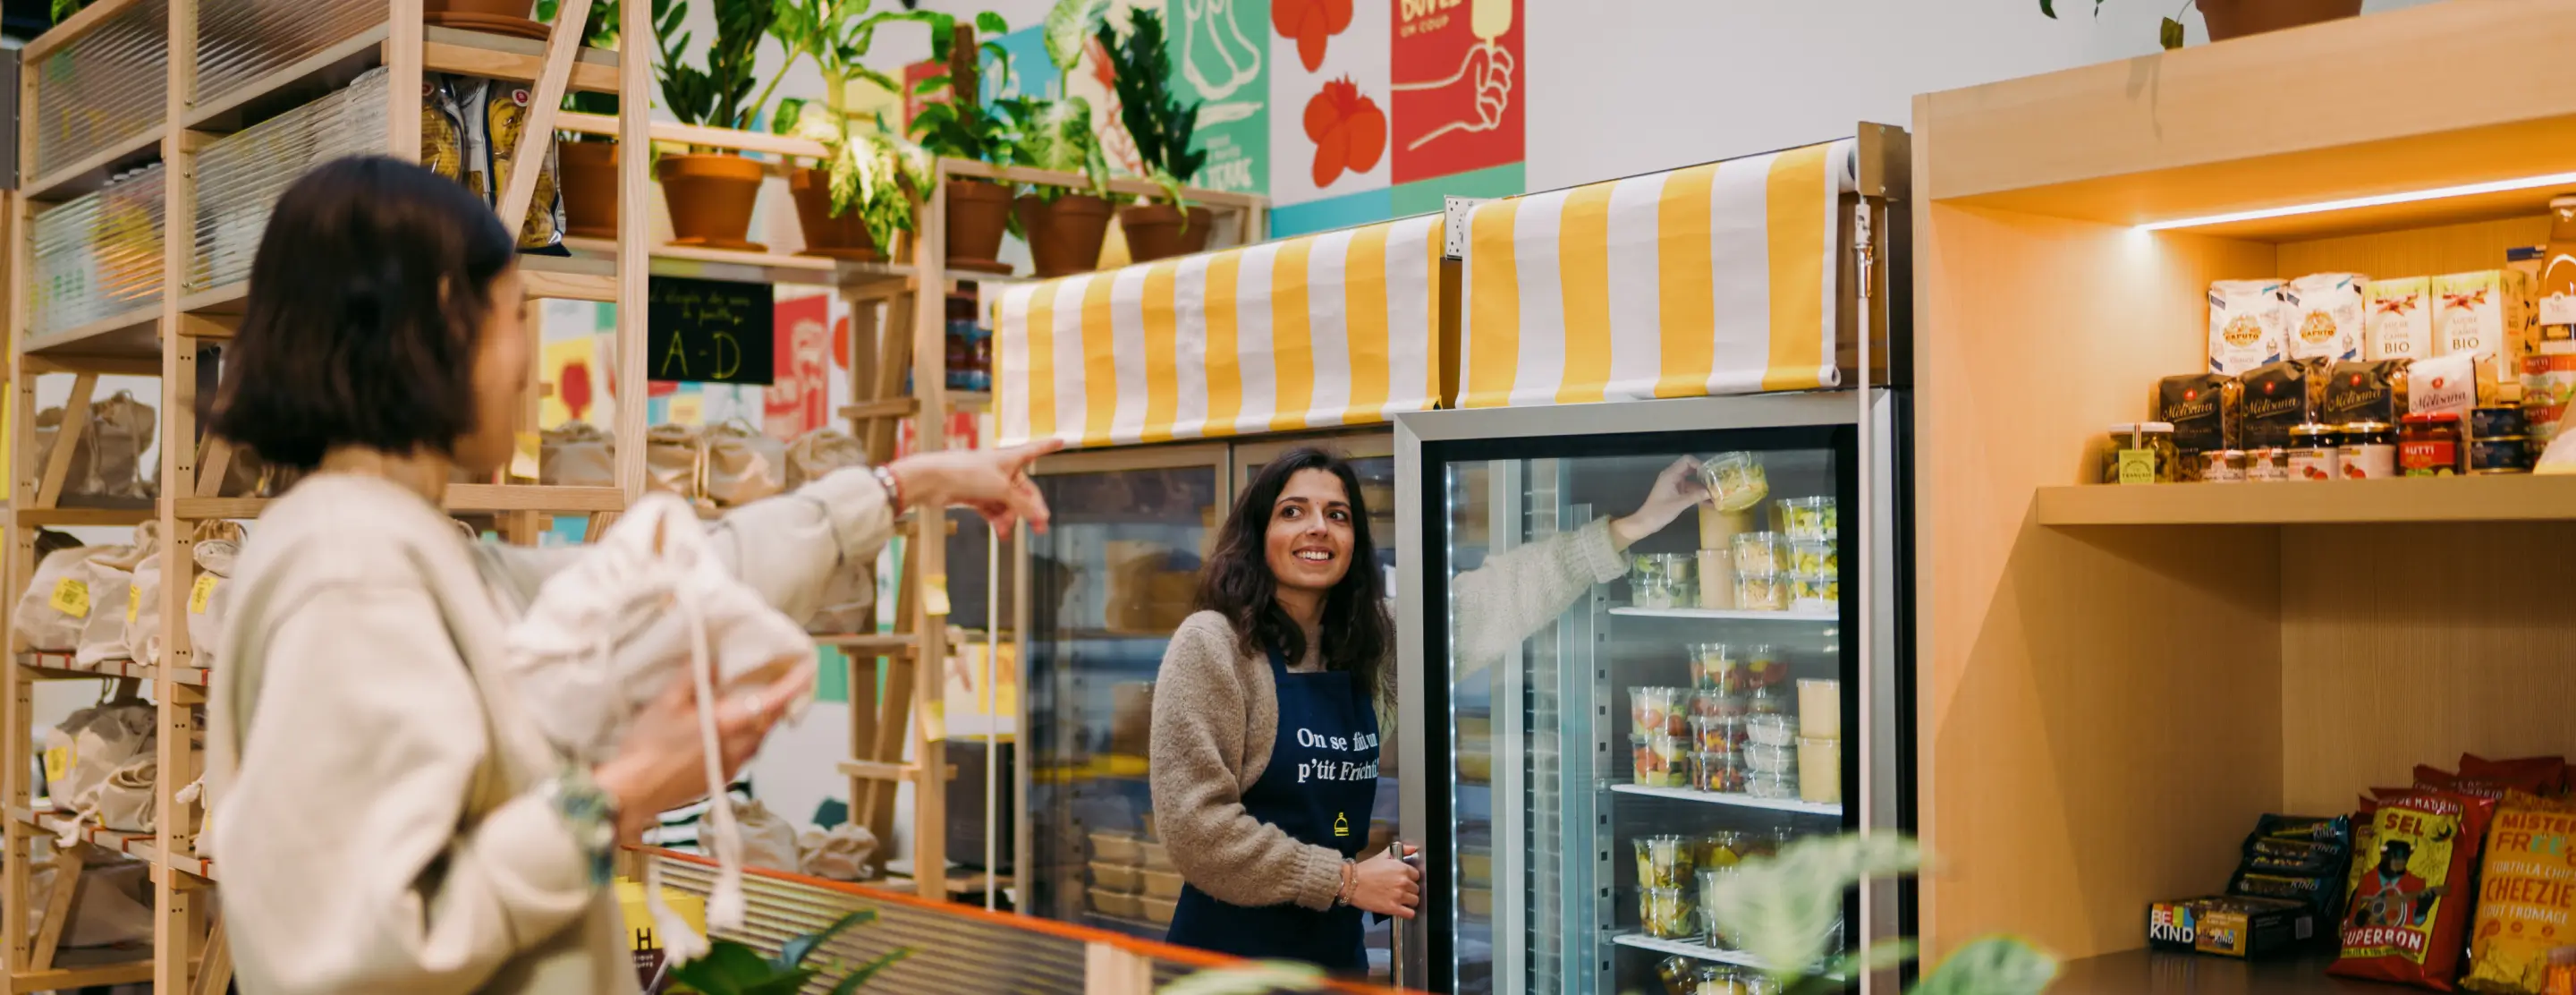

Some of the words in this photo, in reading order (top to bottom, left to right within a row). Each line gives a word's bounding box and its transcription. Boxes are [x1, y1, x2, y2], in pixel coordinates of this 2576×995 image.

[2384, 342, 2410, 353] BIO
[2453, 337, 2479, 351] BIO
[1297, 727, 1328, 749] On
[1329, 736, 1348, 752] se
[1298, 759, 1336, 783] p'tit
[2414, 796, 2459, 813] MADRID
[2385, 812, 2424, 838] SEL
[2290, 880, 2318, 891] KIND
[2151, 910, 2172, 925] BE
[2509, 905, 2568, 925] FROMAGE
[2149, 923, 2194, 944] KIND
